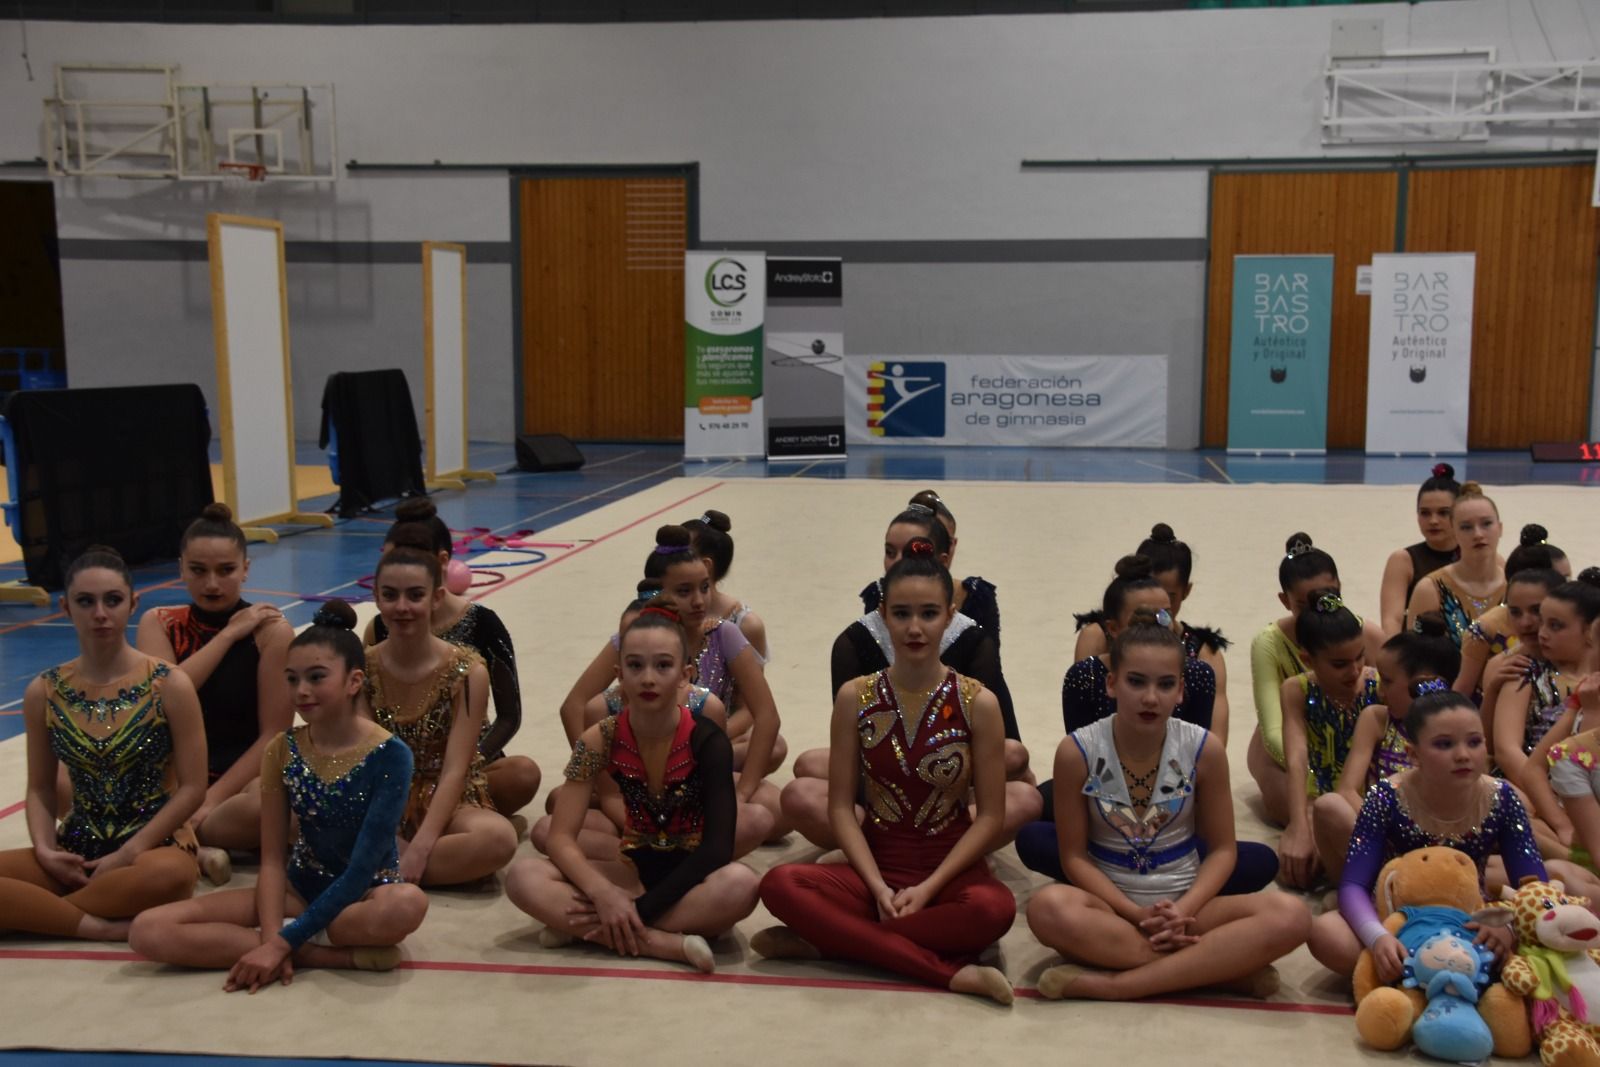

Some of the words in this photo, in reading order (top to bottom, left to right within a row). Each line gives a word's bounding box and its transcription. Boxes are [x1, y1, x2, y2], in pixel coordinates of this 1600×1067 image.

[712, 274, 746, 290] LCS
[1255, 273, 1309, 292] BAR
[1394, 272, 1449, 291] BAR
[1254, 294, 1309, 313] BAS
[1393, 293, 1449, 312] BAS
[1254, 314, 1310, 334] TRO
[1392, 314, 1449, 332] TRO
[1253, 336, 1307, 347] Auténtico
[1392, 336, 1447, 346] Auténtico
[1253, 351, 1259, 361] y
[1263, 348, 1306, 361] Original
[1391, 351, 1398, 361] y
[1402, 347, 1446, 361] Original
[971, 375, 1082, 388] federación
[951, 392, 1101, 409] aragonesa
[965, 412, 990, 425] de
[996, 412, 1087, 428] gimnasia
